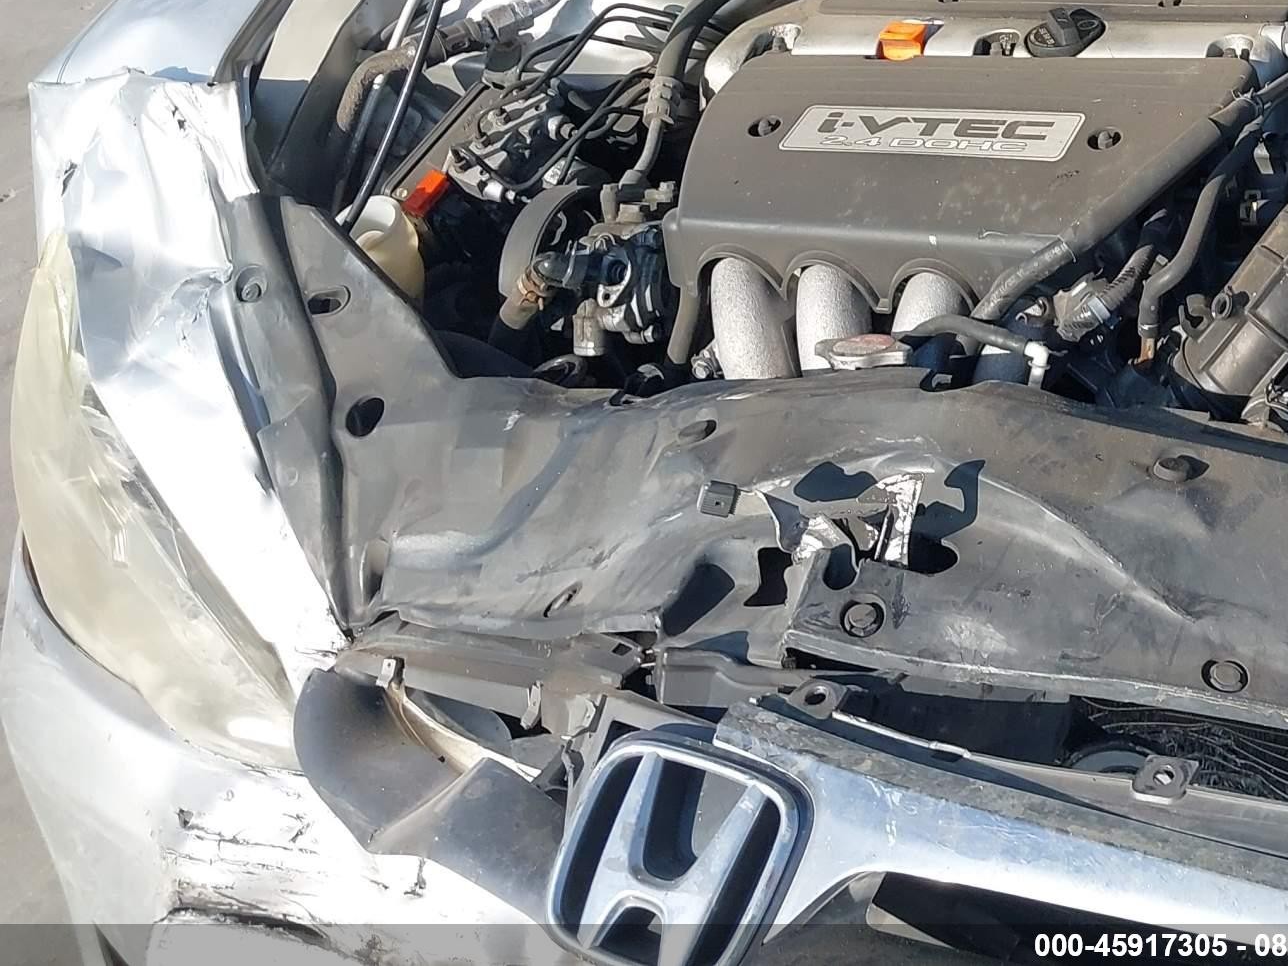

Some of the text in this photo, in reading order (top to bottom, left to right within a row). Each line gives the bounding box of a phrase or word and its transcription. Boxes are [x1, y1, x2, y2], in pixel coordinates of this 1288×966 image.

[817, 111, 1056, 141] i-VTEC
[819, 135, 1029, 153] 2.4 DOHC
